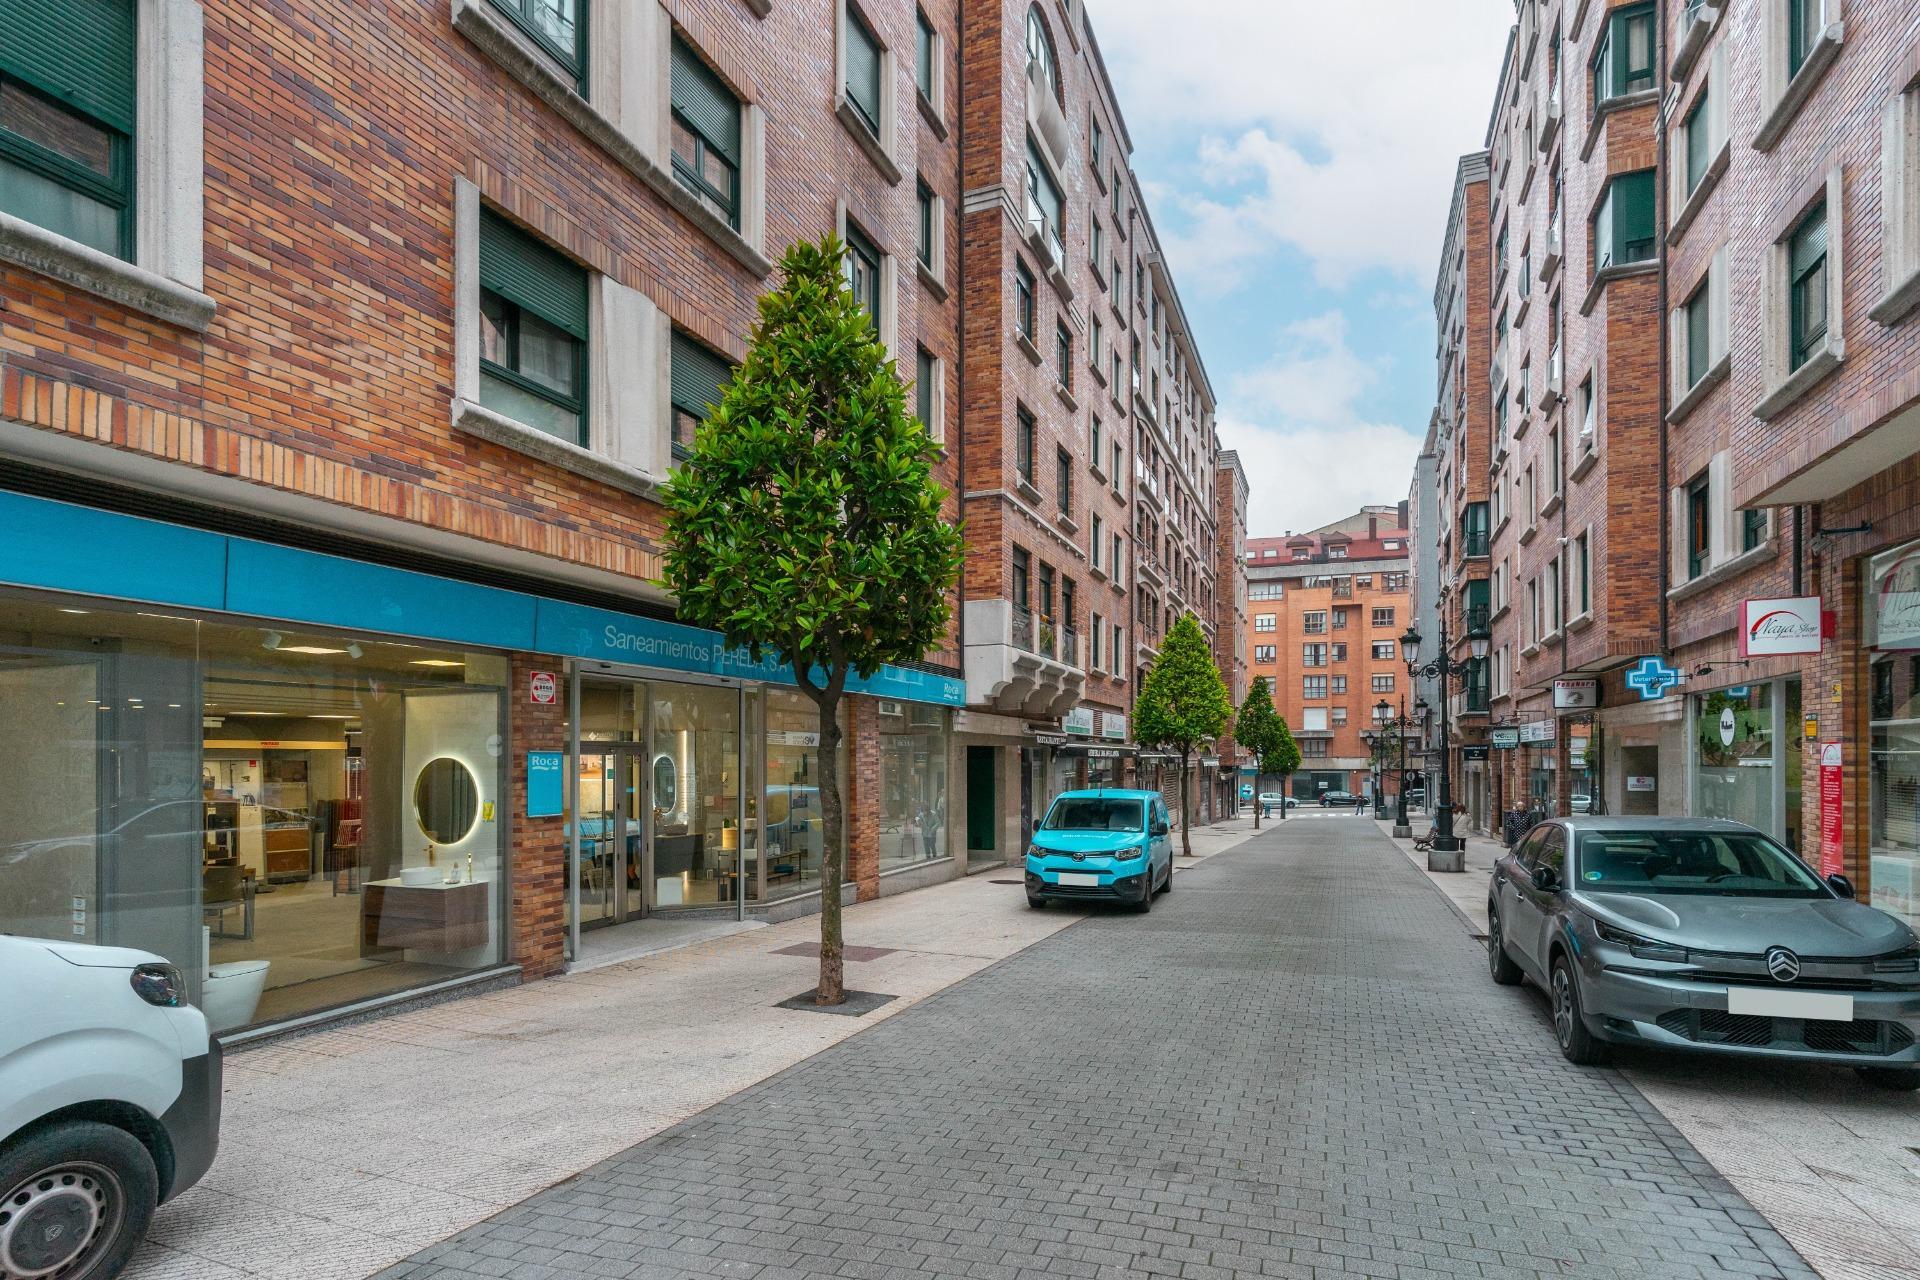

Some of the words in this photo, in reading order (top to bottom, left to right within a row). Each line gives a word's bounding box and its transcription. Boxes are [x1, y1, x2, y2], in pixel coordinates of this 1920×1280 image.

[1758, 618, 1796, 640] Naya
[604, 625, 709, 662] Saneamientos
[944, 682, 959, 695] Roca
[531, 755, 559, 766] Roca
